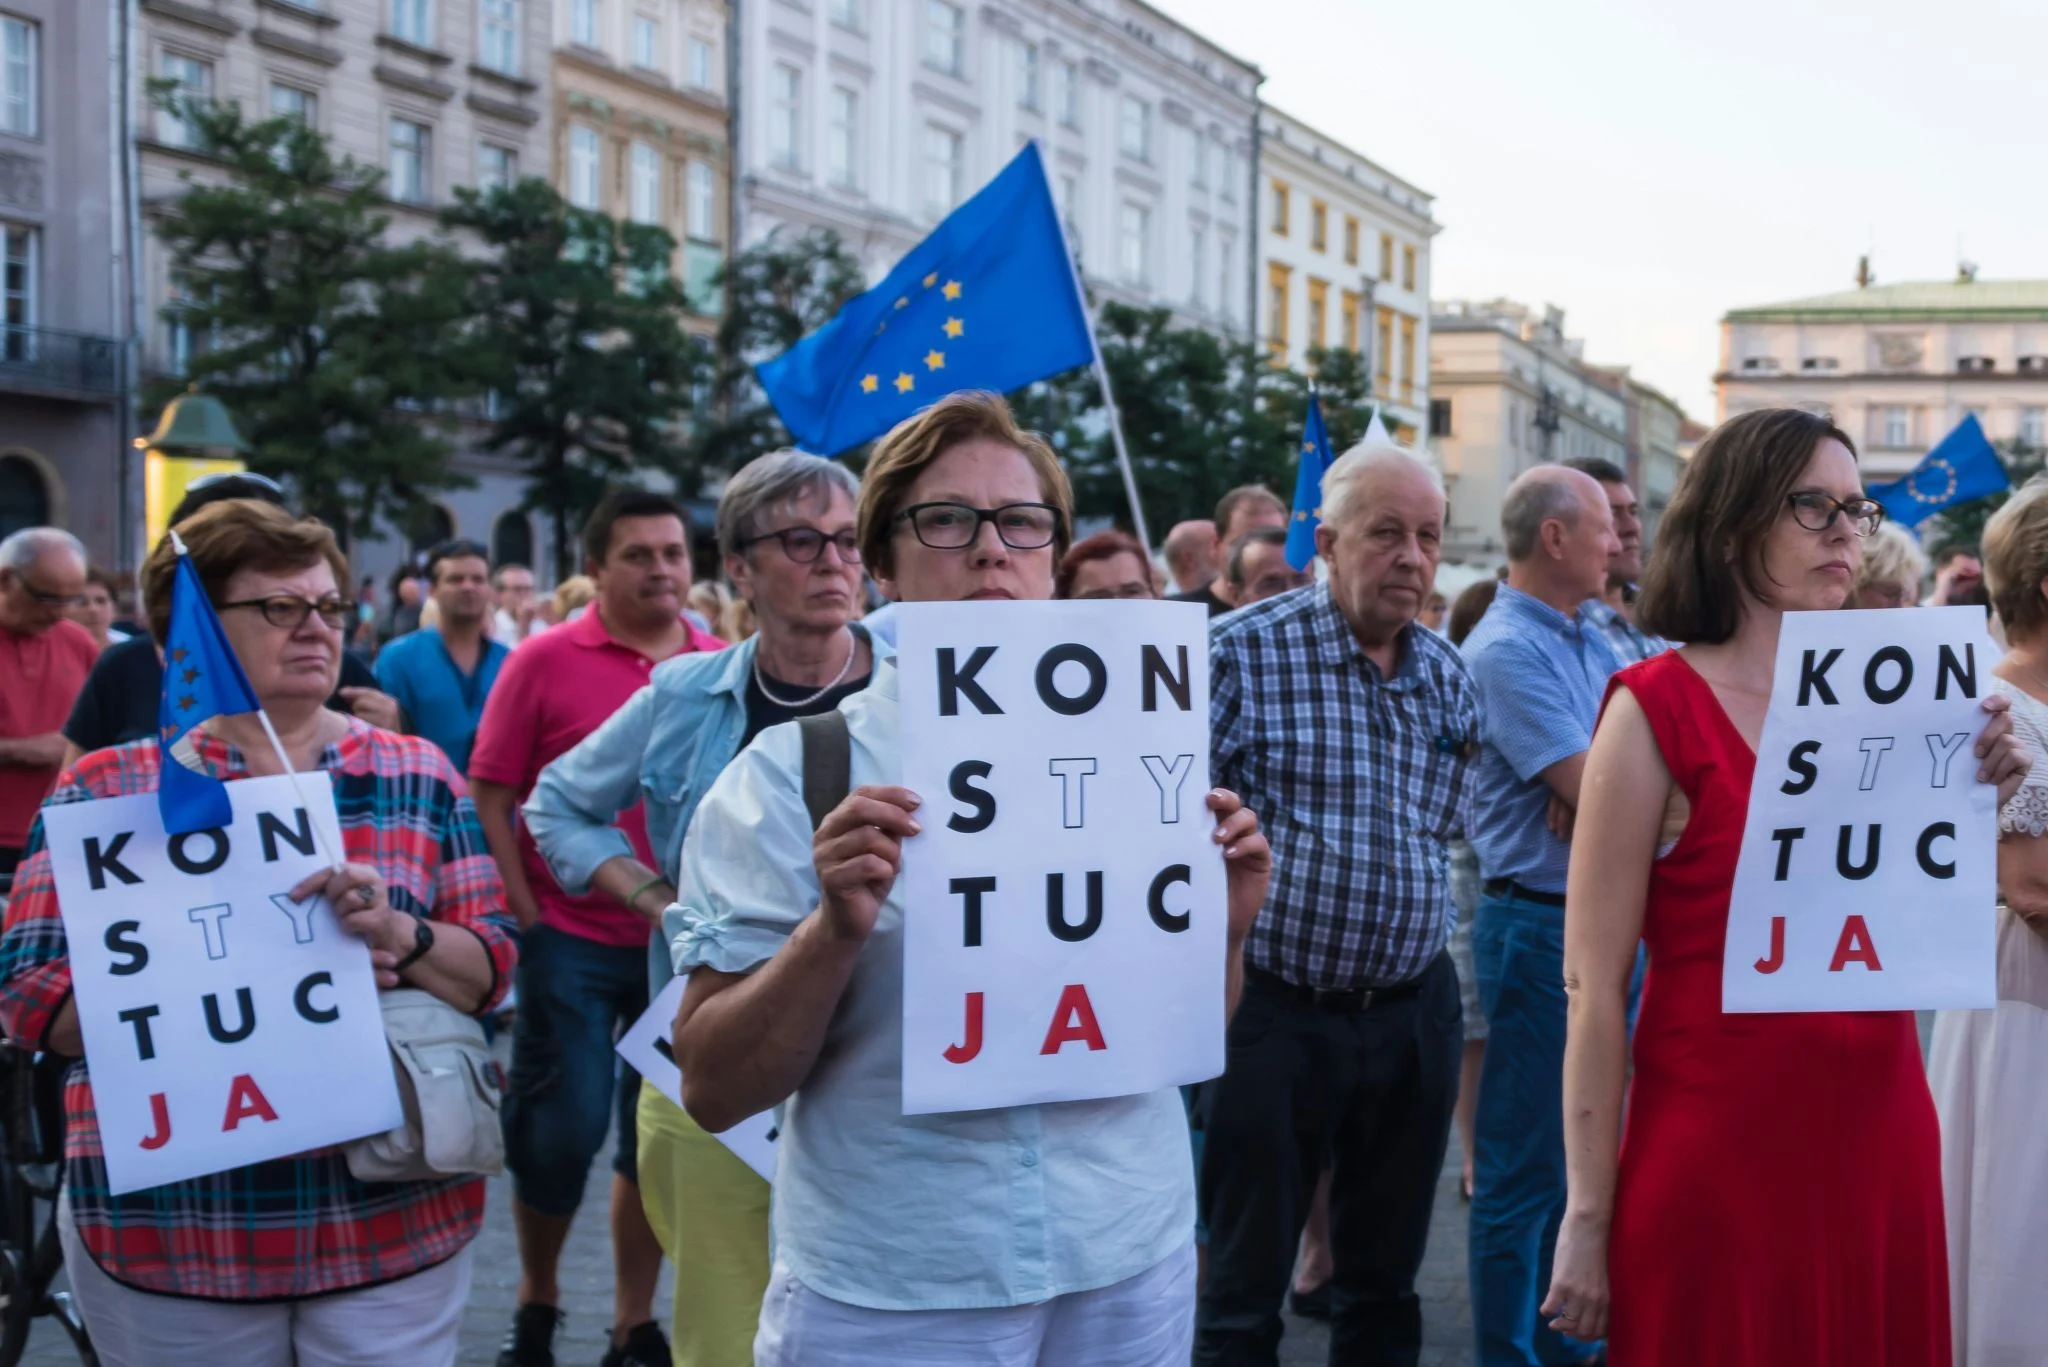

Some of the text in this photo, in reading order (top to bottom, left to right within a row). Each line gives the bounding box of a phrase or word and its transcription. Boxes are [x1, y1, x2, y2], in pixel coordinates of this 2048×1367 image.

[936, 643, 1192, 716] KON
[1796, 643, 1977, 706] KON
[947, 755, 1194, 833] STY
[1780, 733, 1969, 795] STY
[82, 808, 316, 890] KON
[1771, 821, 1956, 881] TUC
[104, 892, 322, 976] STY
[949, 864, 1191, 947] TUC
[1753, 915, 1883, 974] JA
[119, 971, 340, 1061] TUC
[942, 984, 1107, 1064] JA
[139, 1074, 279, 1151] JA
